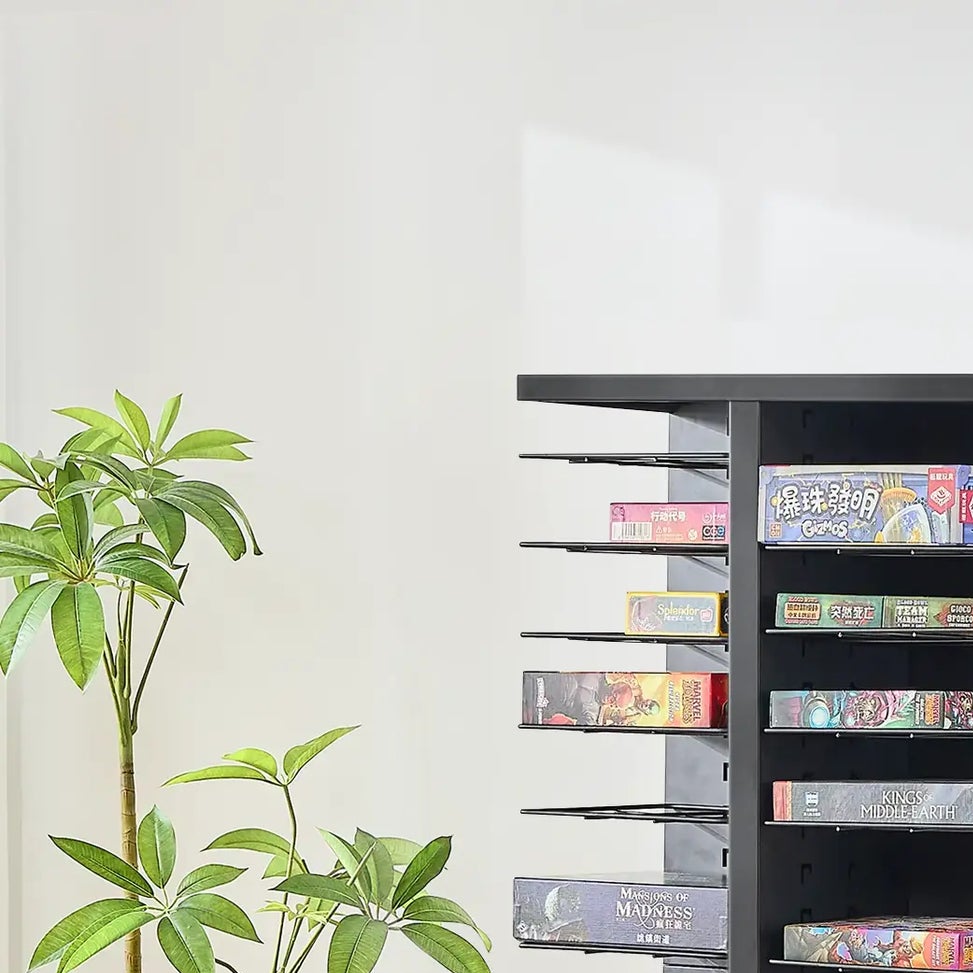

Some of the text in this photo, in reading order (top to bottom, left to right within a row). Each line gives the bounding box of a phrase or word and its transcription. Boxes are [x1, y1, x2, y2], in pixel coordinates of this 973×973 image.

[775, 481, 881, 520] 爆珠發明
[650, 510, 686, 522] 行动代号
[657, 601, 699, 617] Splendor
[830, 605, 875, 620] 突然死亡
[895, 605, 929, 616] TEAM
[950, 604, 972, 614] GIOCO
[895, 615, 928, 624] MANAGER
[946, 613, 973, 624] SPORCO
[694, 680, 702, 722] MARVEL
[882, 790, 924, 804] KINGS
[860, 804, 957, 821] MIDDLE-EARTH
[620, 886, 690, 903] MANSIONS OF
[616, 900, 693, 920] MADNESS
